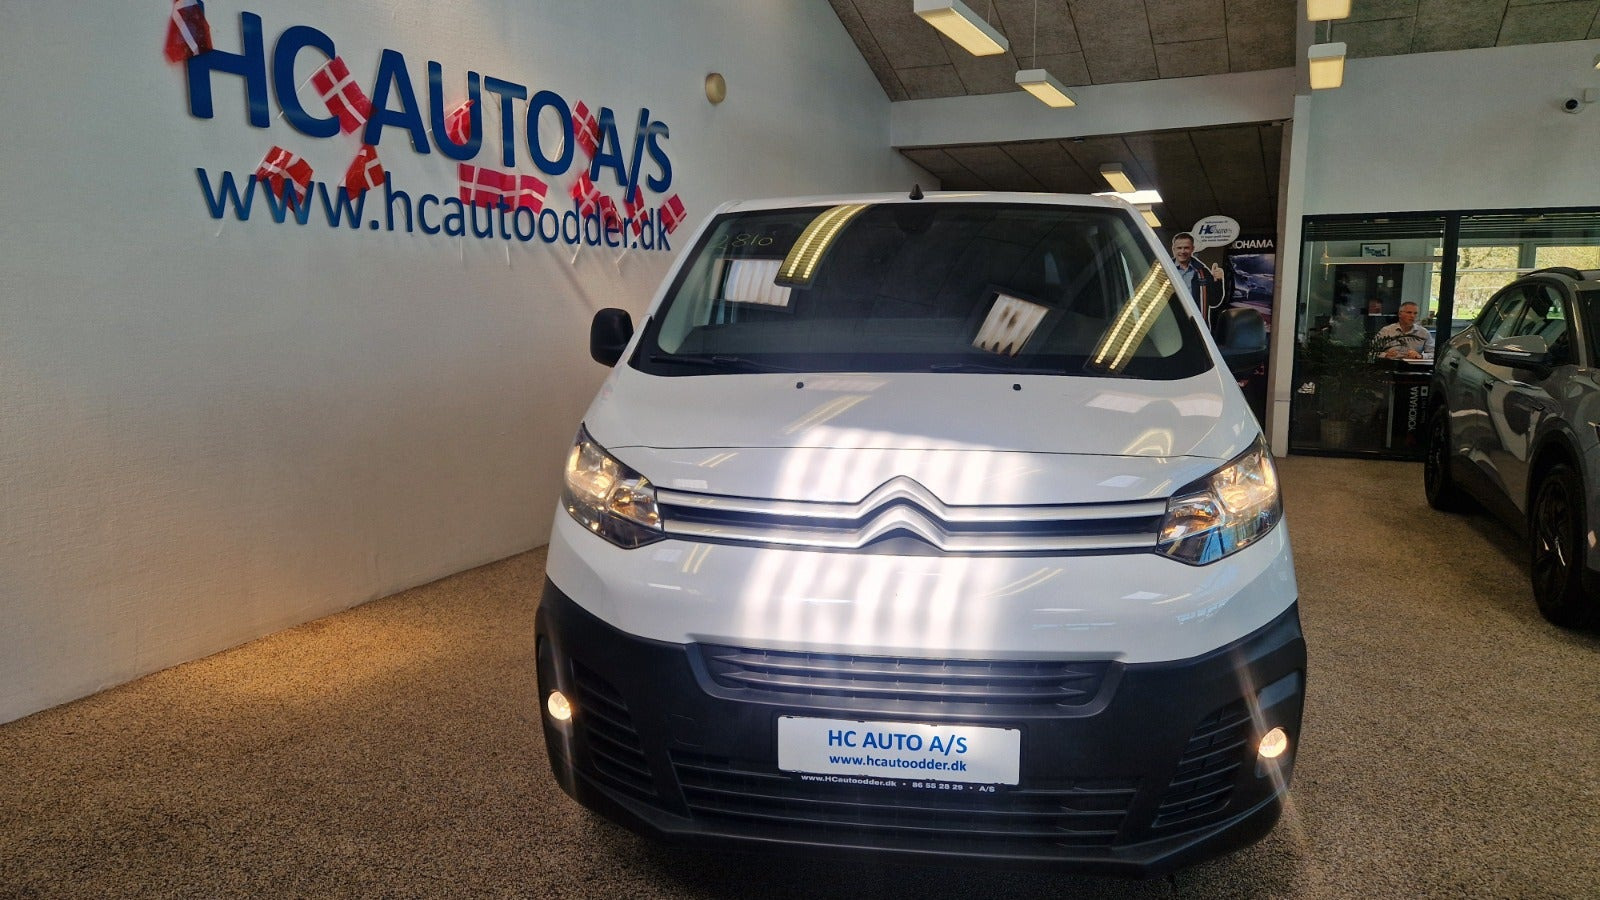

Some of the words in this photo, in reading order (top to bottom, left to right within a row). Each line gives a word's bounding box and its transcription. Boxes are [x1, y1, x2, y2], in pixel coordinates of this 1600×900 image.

[186, 11, 341, 138] HC
[363, 48, 574, 176] AUTO
[589, 107, 673, 203] A/S
[196, 167, 672, 252] www.hcautoodder.dk
[1408, 386, 1420, 431] YOKOHAMA
[828, 730, 857, 748] HC
[862, 732, 923, 751] AUTO
[928, 734, 968, 756] A/S
[829, 755, 967, 772] www.hcautoodder.dk
[801, 774, 897, 787] www.HCautoodder.dk
[978, 785, 995, 793] A/S
